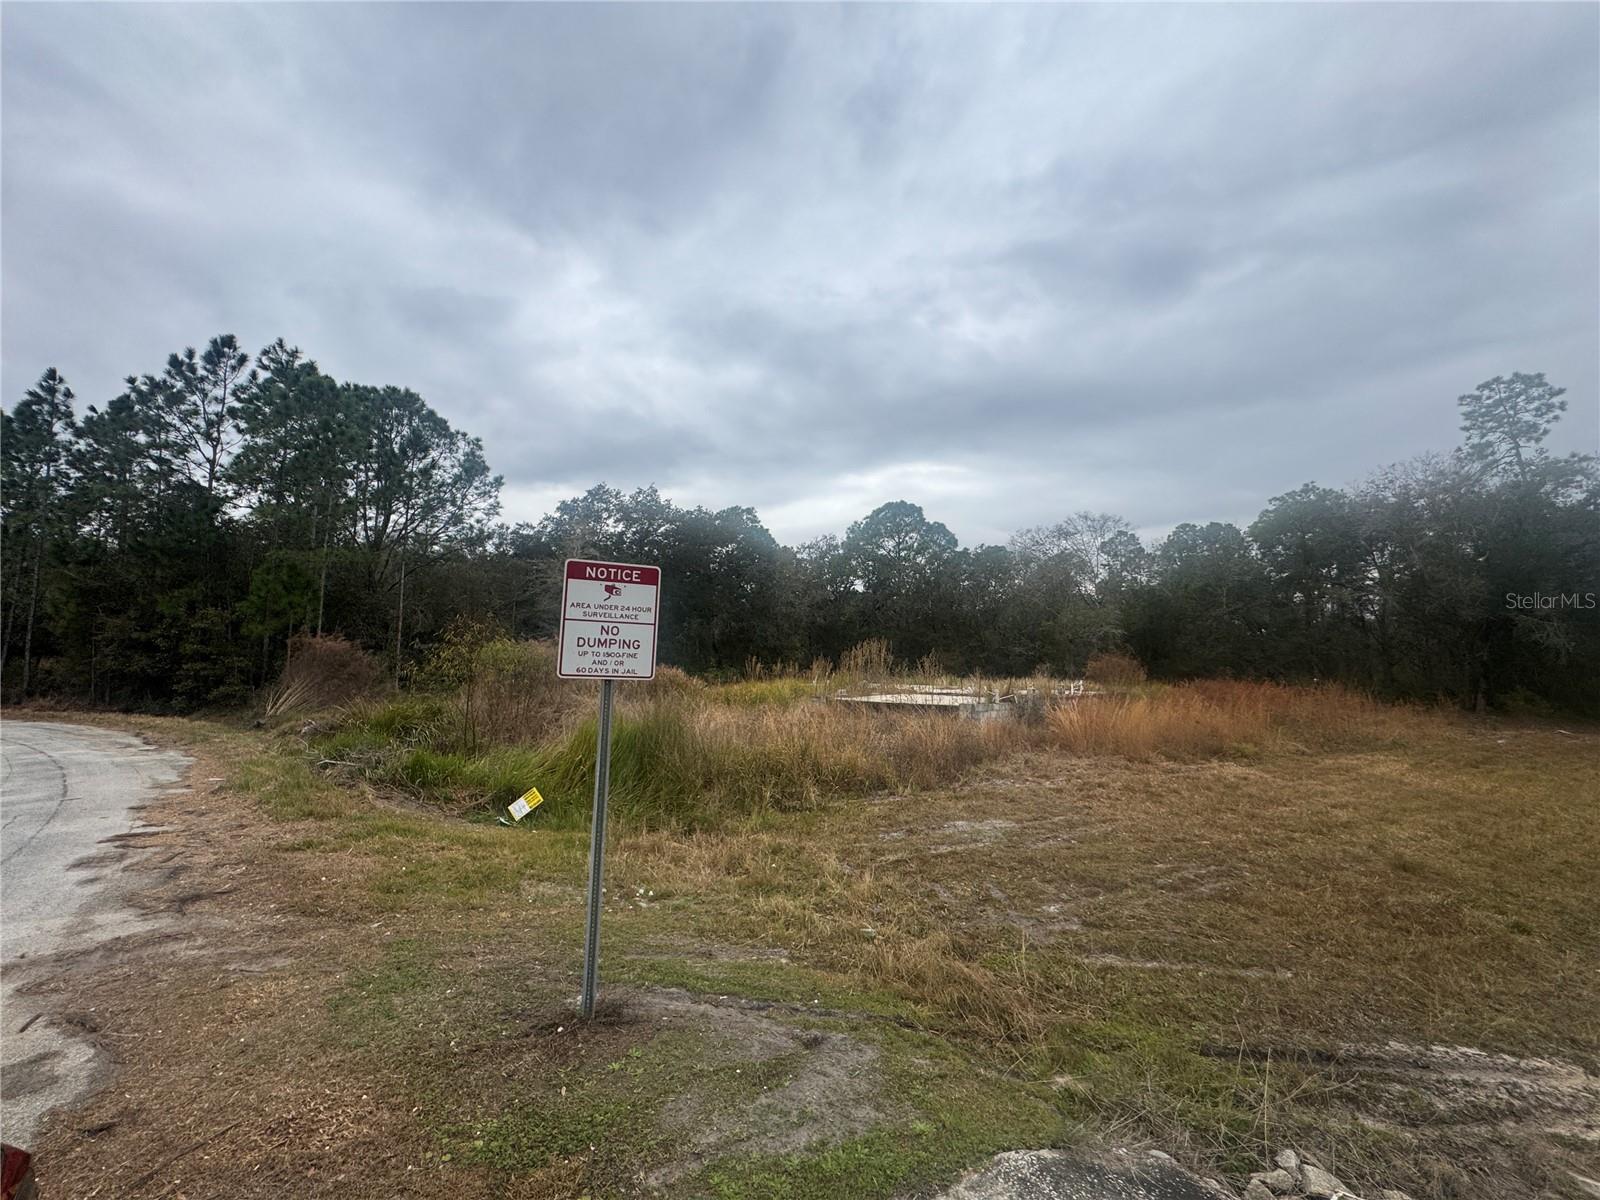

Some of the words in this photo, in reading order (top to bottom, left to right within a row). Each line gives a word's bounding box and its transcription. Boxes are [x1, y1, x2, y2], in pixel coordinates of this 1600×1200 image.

[585, 566, 641, 582] NOTICE
[594, 603, 618, 611] UNDER
[582, 610, 639, 620] SURVEILLANCE
[600, 625, 620, 636] NO
[576, 637, 641, 650] DUMPING
